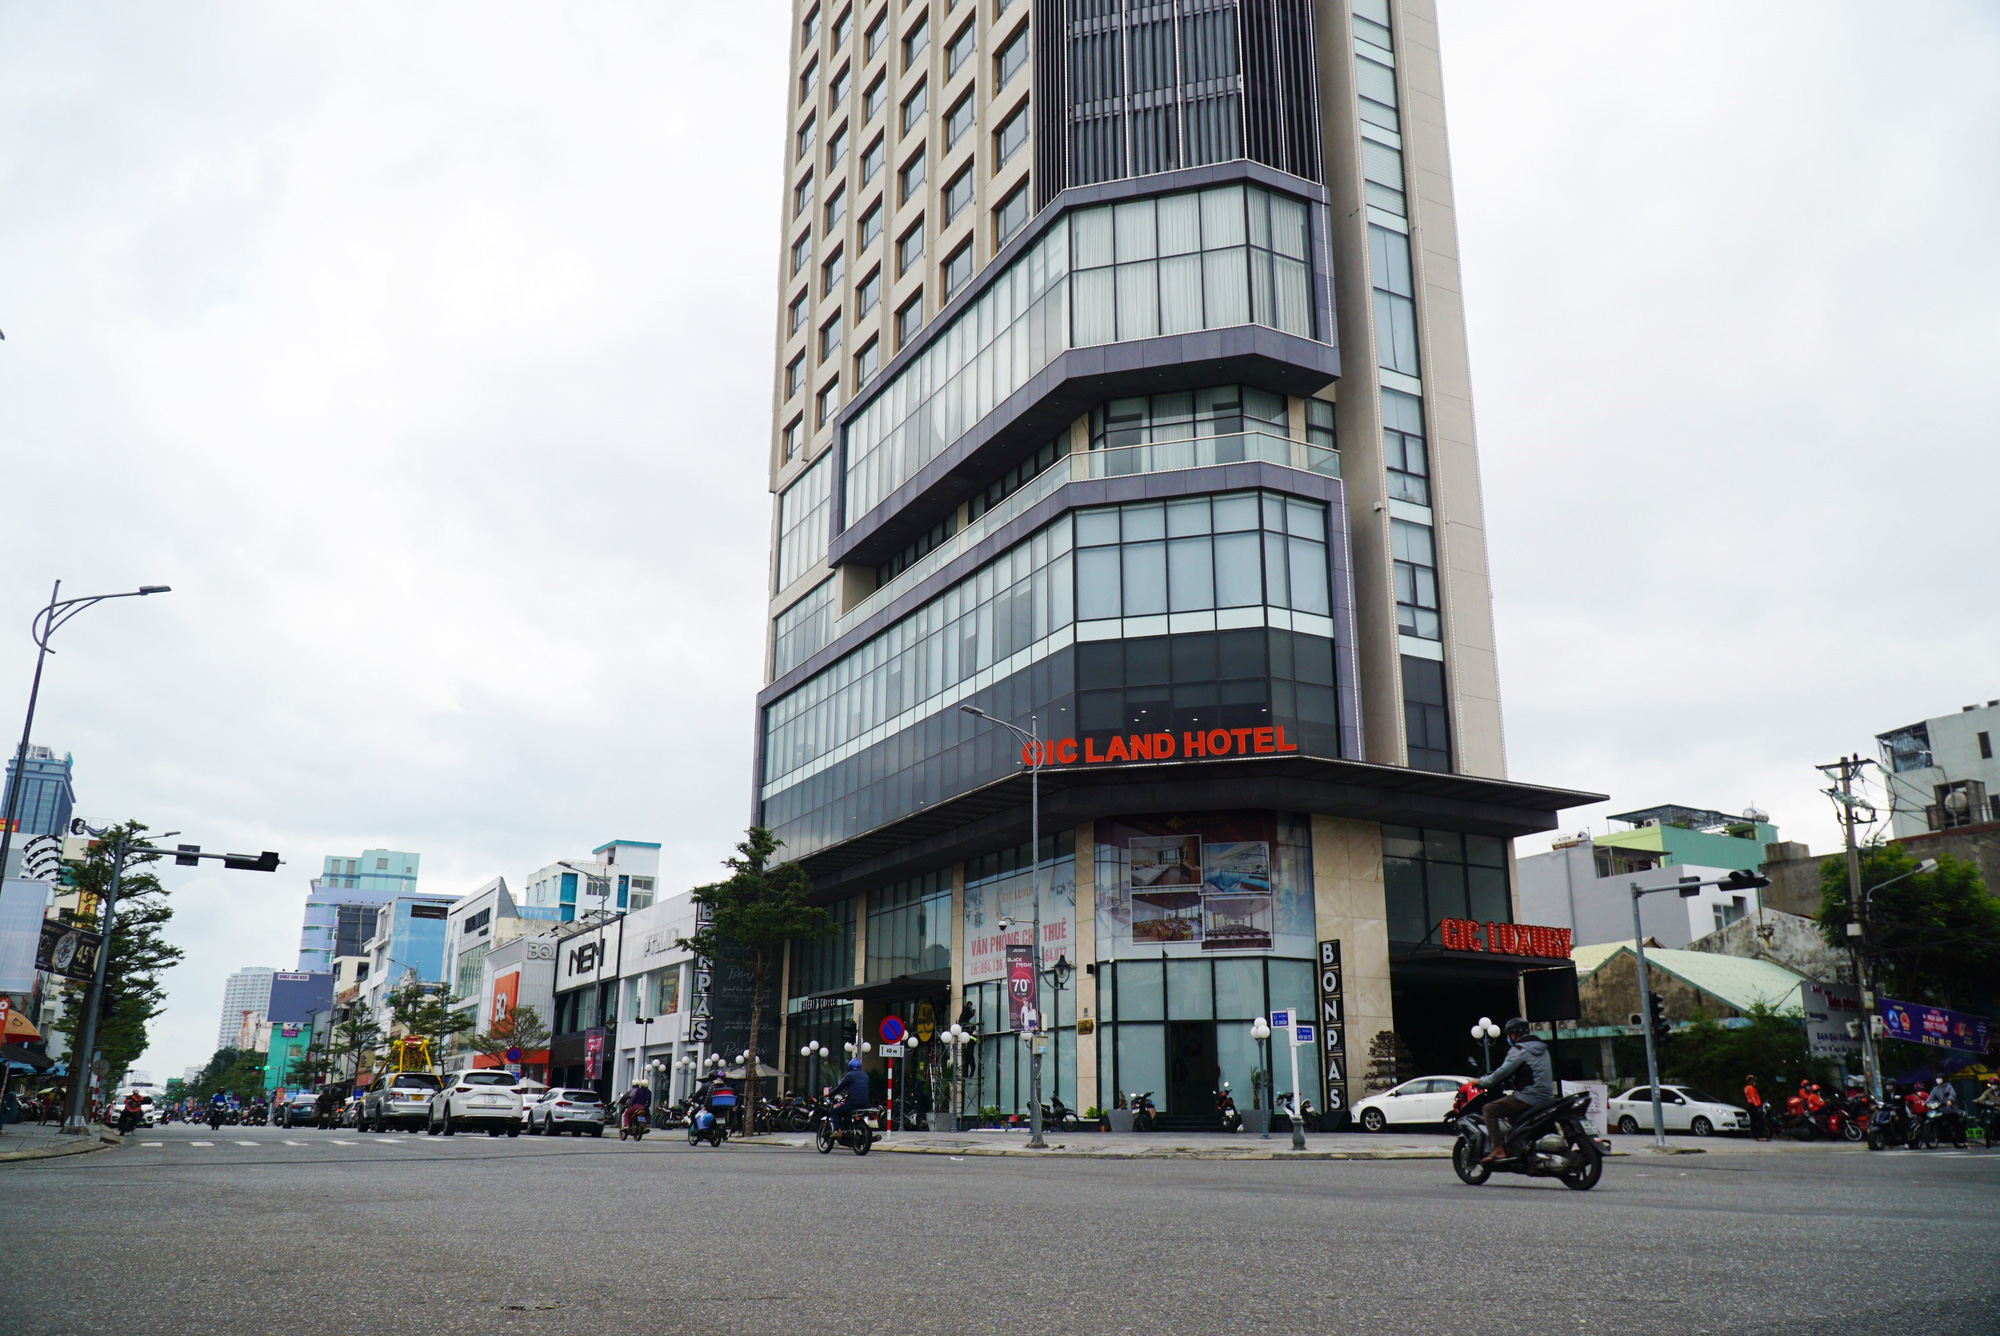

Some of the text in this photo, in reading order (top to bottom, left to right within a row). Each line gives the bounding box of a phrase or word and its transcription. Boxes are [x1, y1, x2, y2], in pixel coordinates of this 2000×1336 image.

[1022, 725, 1298, 766] GIC LAND HOTEL
[1014, 887, 1034, 900] LUXUR
[527, 942, 556, 960] BQ
[971, 917, 1067, 957] VĂN PHÒNG CH THUÊ
[1441, 917, 1572, 959] GIC LUXURY
[568, 938, 605, 977] NEM
[1322, 943, 1341, 1110] BONPAS
